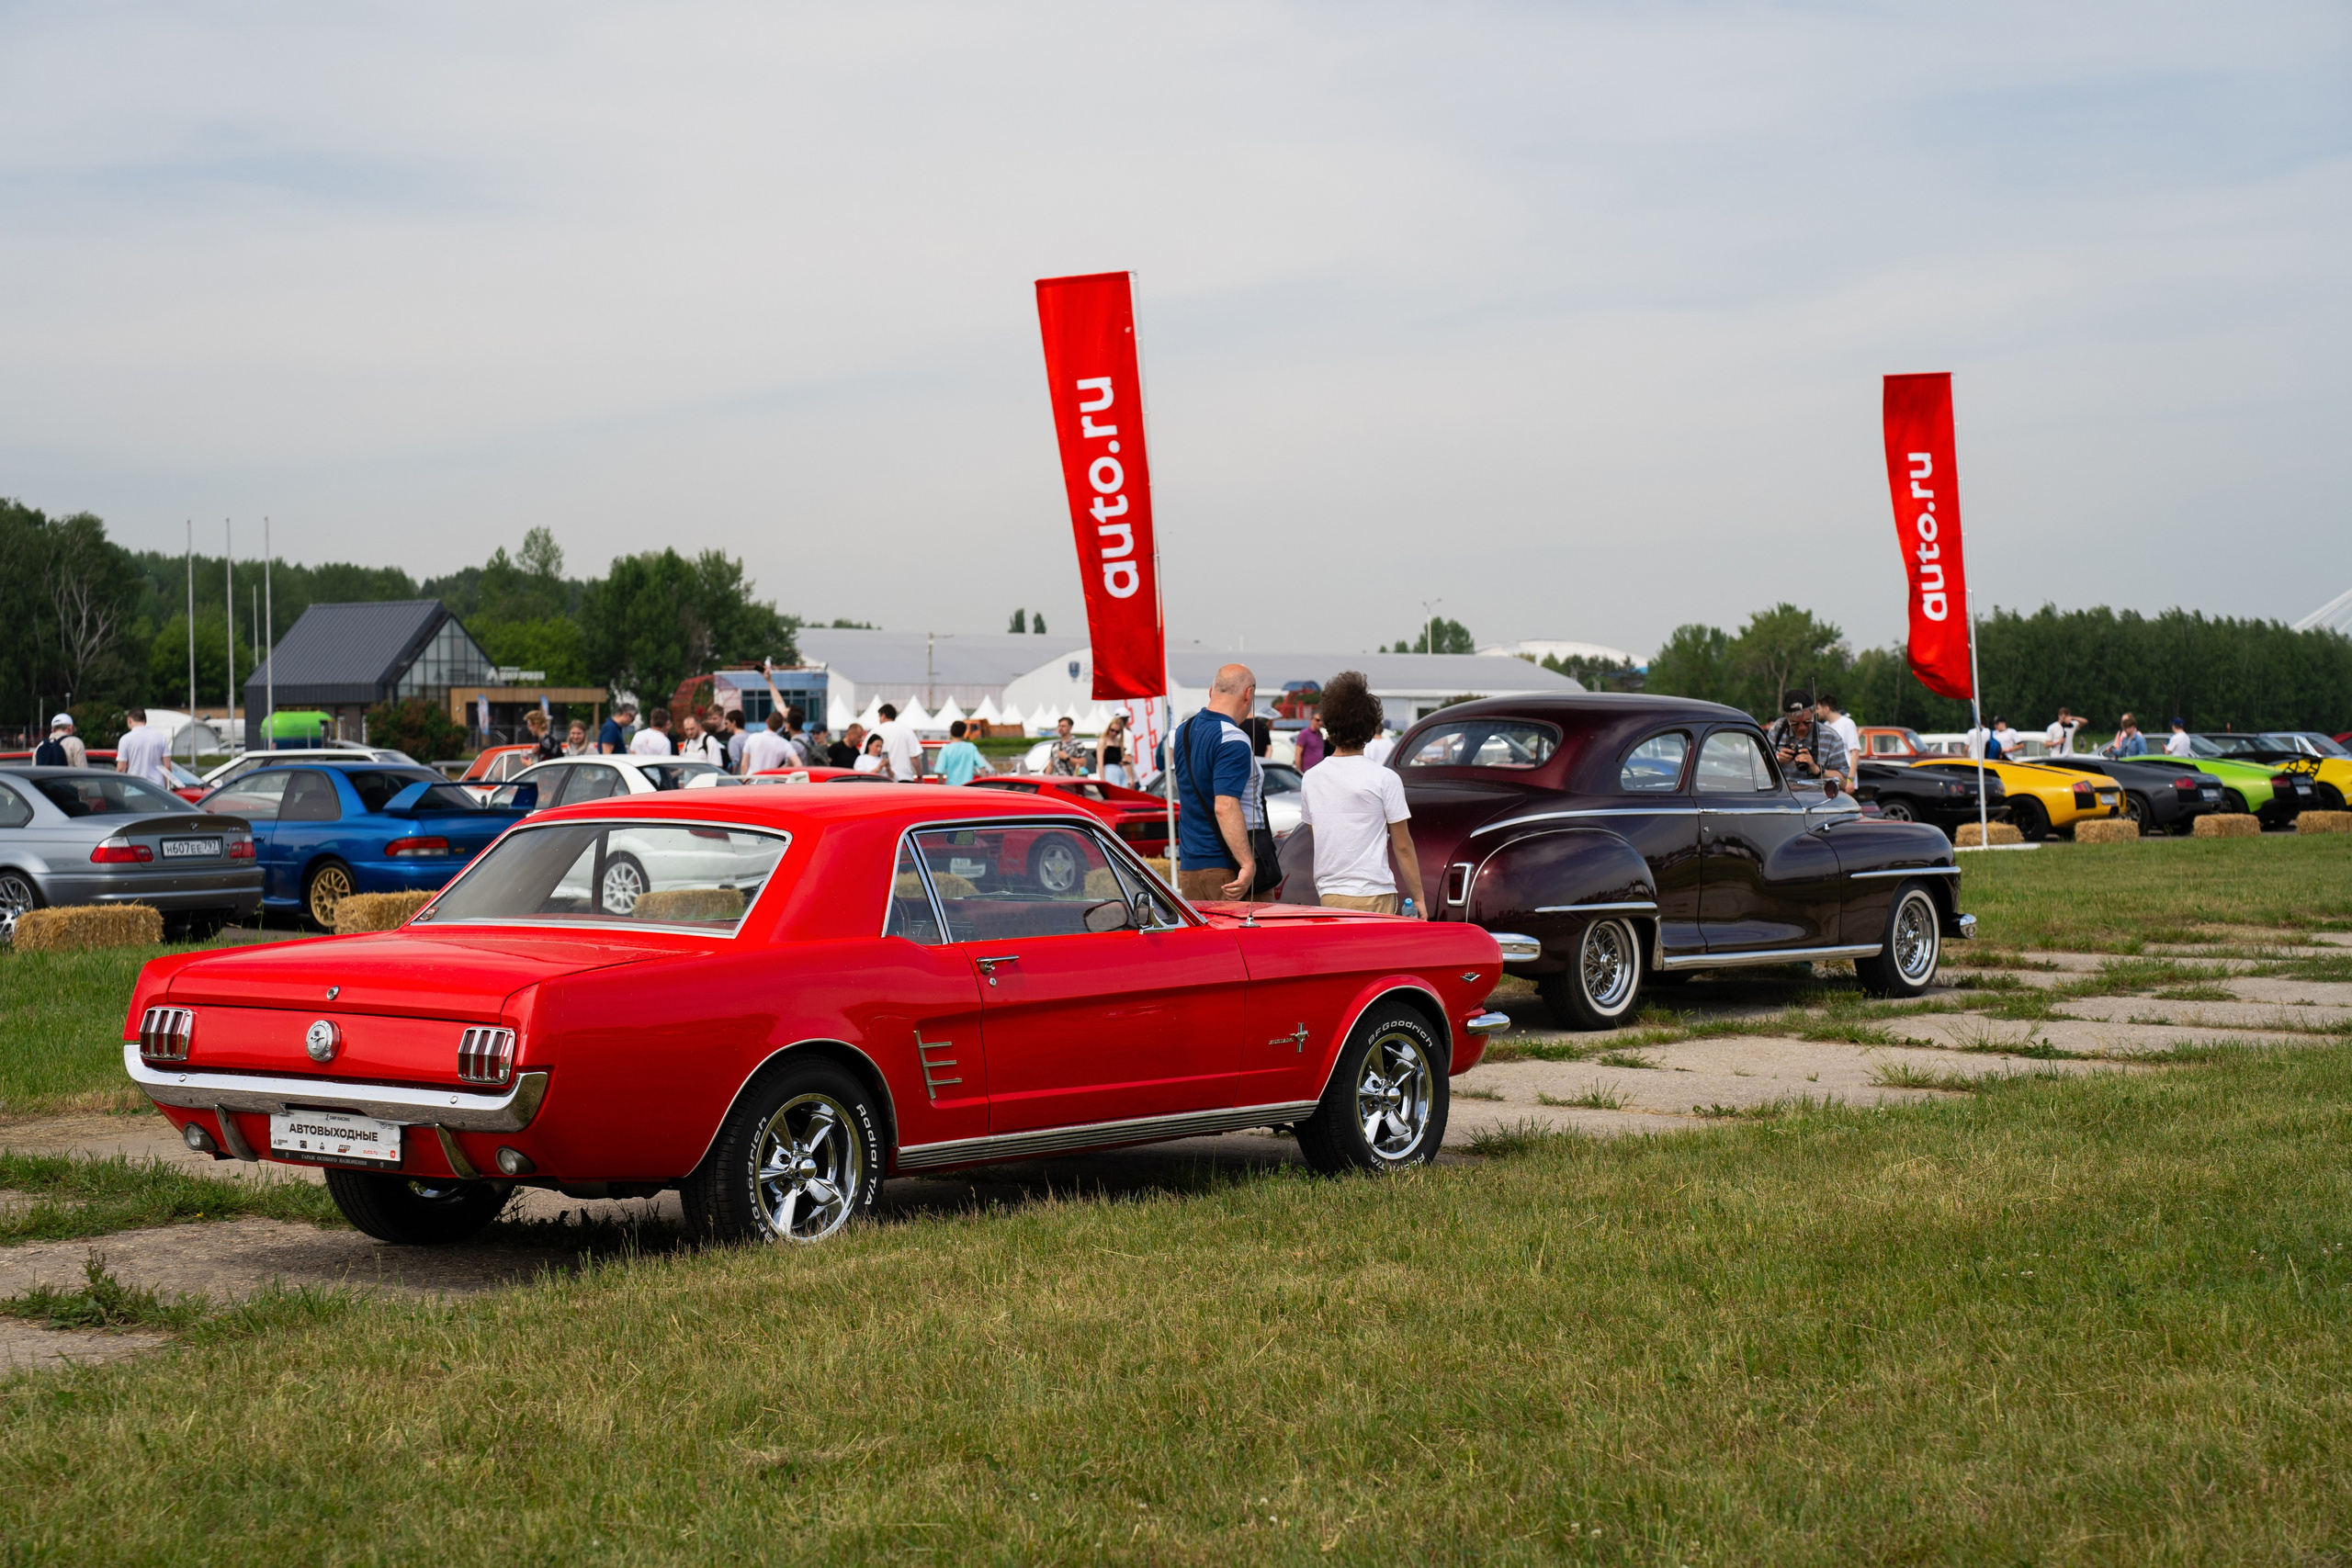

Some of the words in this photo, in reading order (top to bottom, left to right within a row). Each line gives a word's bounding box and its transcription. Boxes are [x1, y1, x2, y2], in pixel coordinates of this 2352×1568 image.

[1077, 376, 1140, 599] auto.ru
[1907, 452, 1948, 622] auto.ru
[1367, 1020, 1433, 1048] BFGoodrich
[288, 1123, 379, 1142] АВТОВЫХОДНЫЕ
[855, 1103, 877, 1169] Radial
[864, 1176, 877, 1205] T/A
